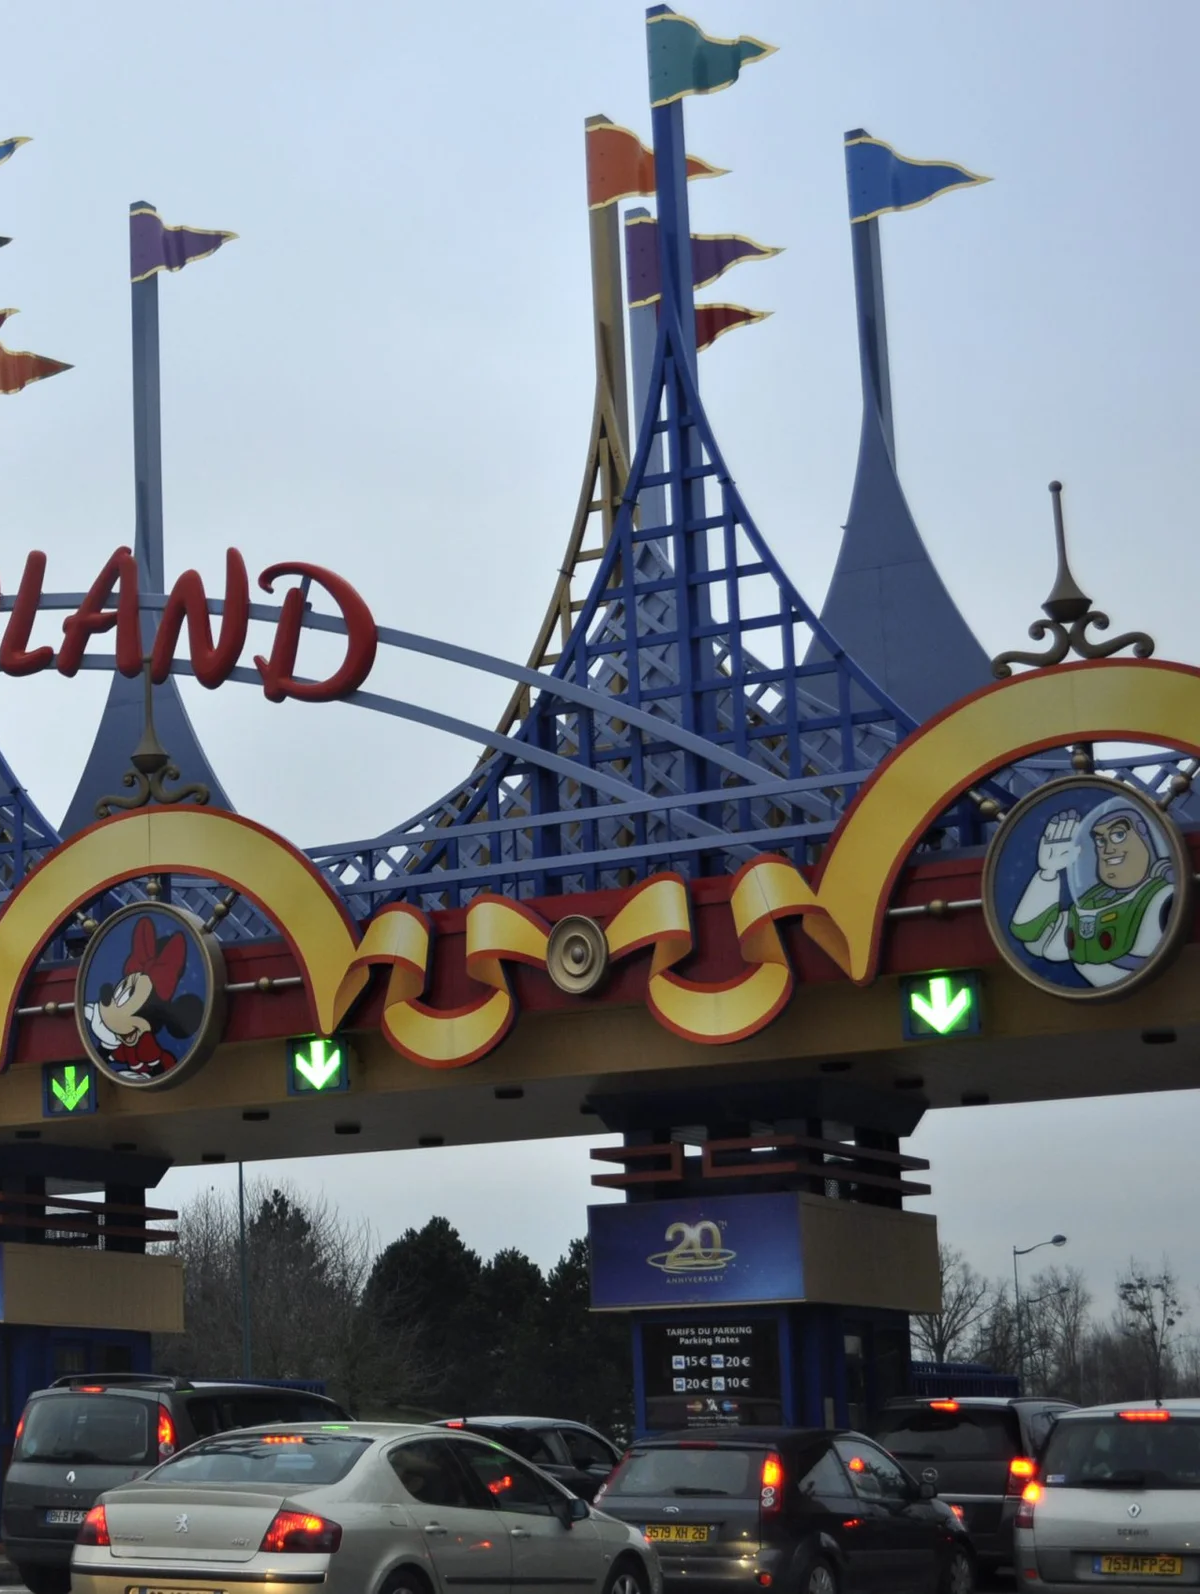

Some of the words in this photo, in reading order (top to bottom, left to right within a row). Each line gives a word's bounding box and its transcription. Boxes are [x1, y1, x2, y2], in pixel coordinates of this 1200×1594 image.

[665, 1220, 722, 1267] 20
[666, 1274, 724, 1284] ANNIVERSARY
[666, 1328, 696, 1336] TARIFS
[698, 1327, 711, 1336] DU
[713, 1326, 753, 1335] PARKING
[679, 1336, 713, 1346] Parking
[715, 1336, 740, 1344] Rates
[675, 1526, 688, 1539] XH
